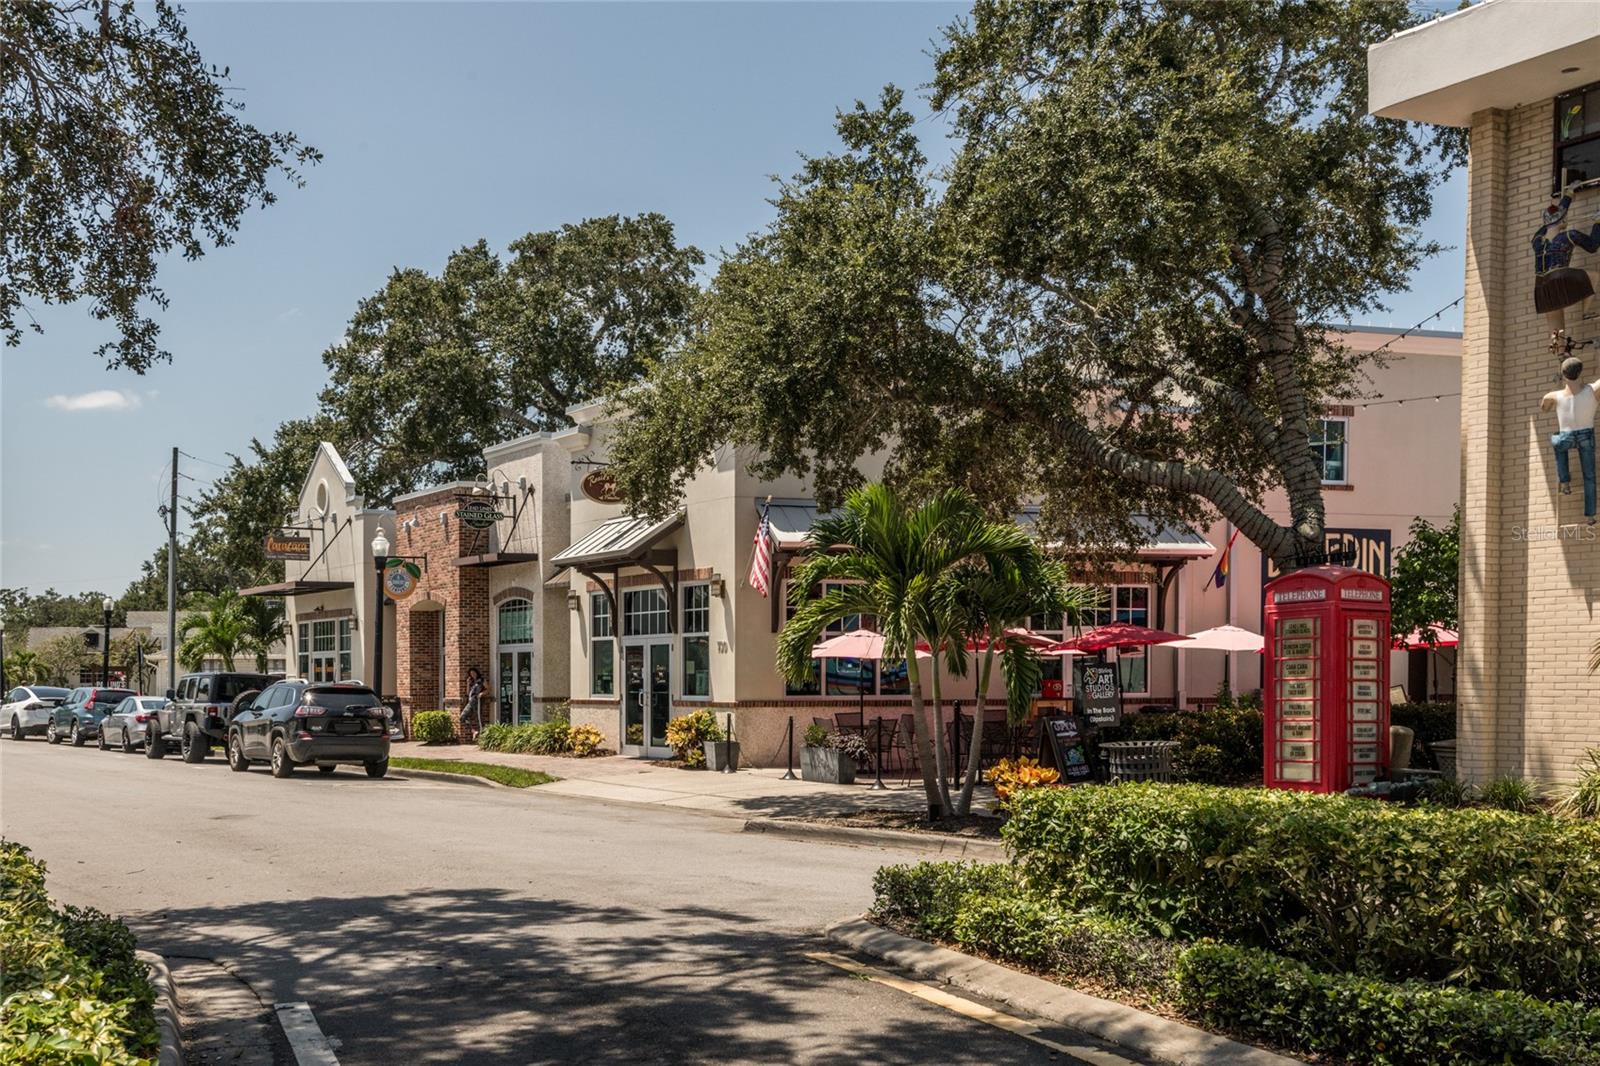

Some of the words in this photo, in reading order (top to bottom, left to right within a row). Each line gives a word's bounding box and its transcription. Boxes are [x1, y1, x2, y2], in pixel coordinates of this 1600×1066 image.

[484, 511, 504, 520] GLASS
[1278, 589, 1324, 602] TELEPHONE
[1344, 589, 1381, 600] TELEPHONE
[1098, 674, 1114, 684] ART
[1085, 684, 1115, 693] STUDIOS
[1091, 691, 1115, 699] GALLERY
